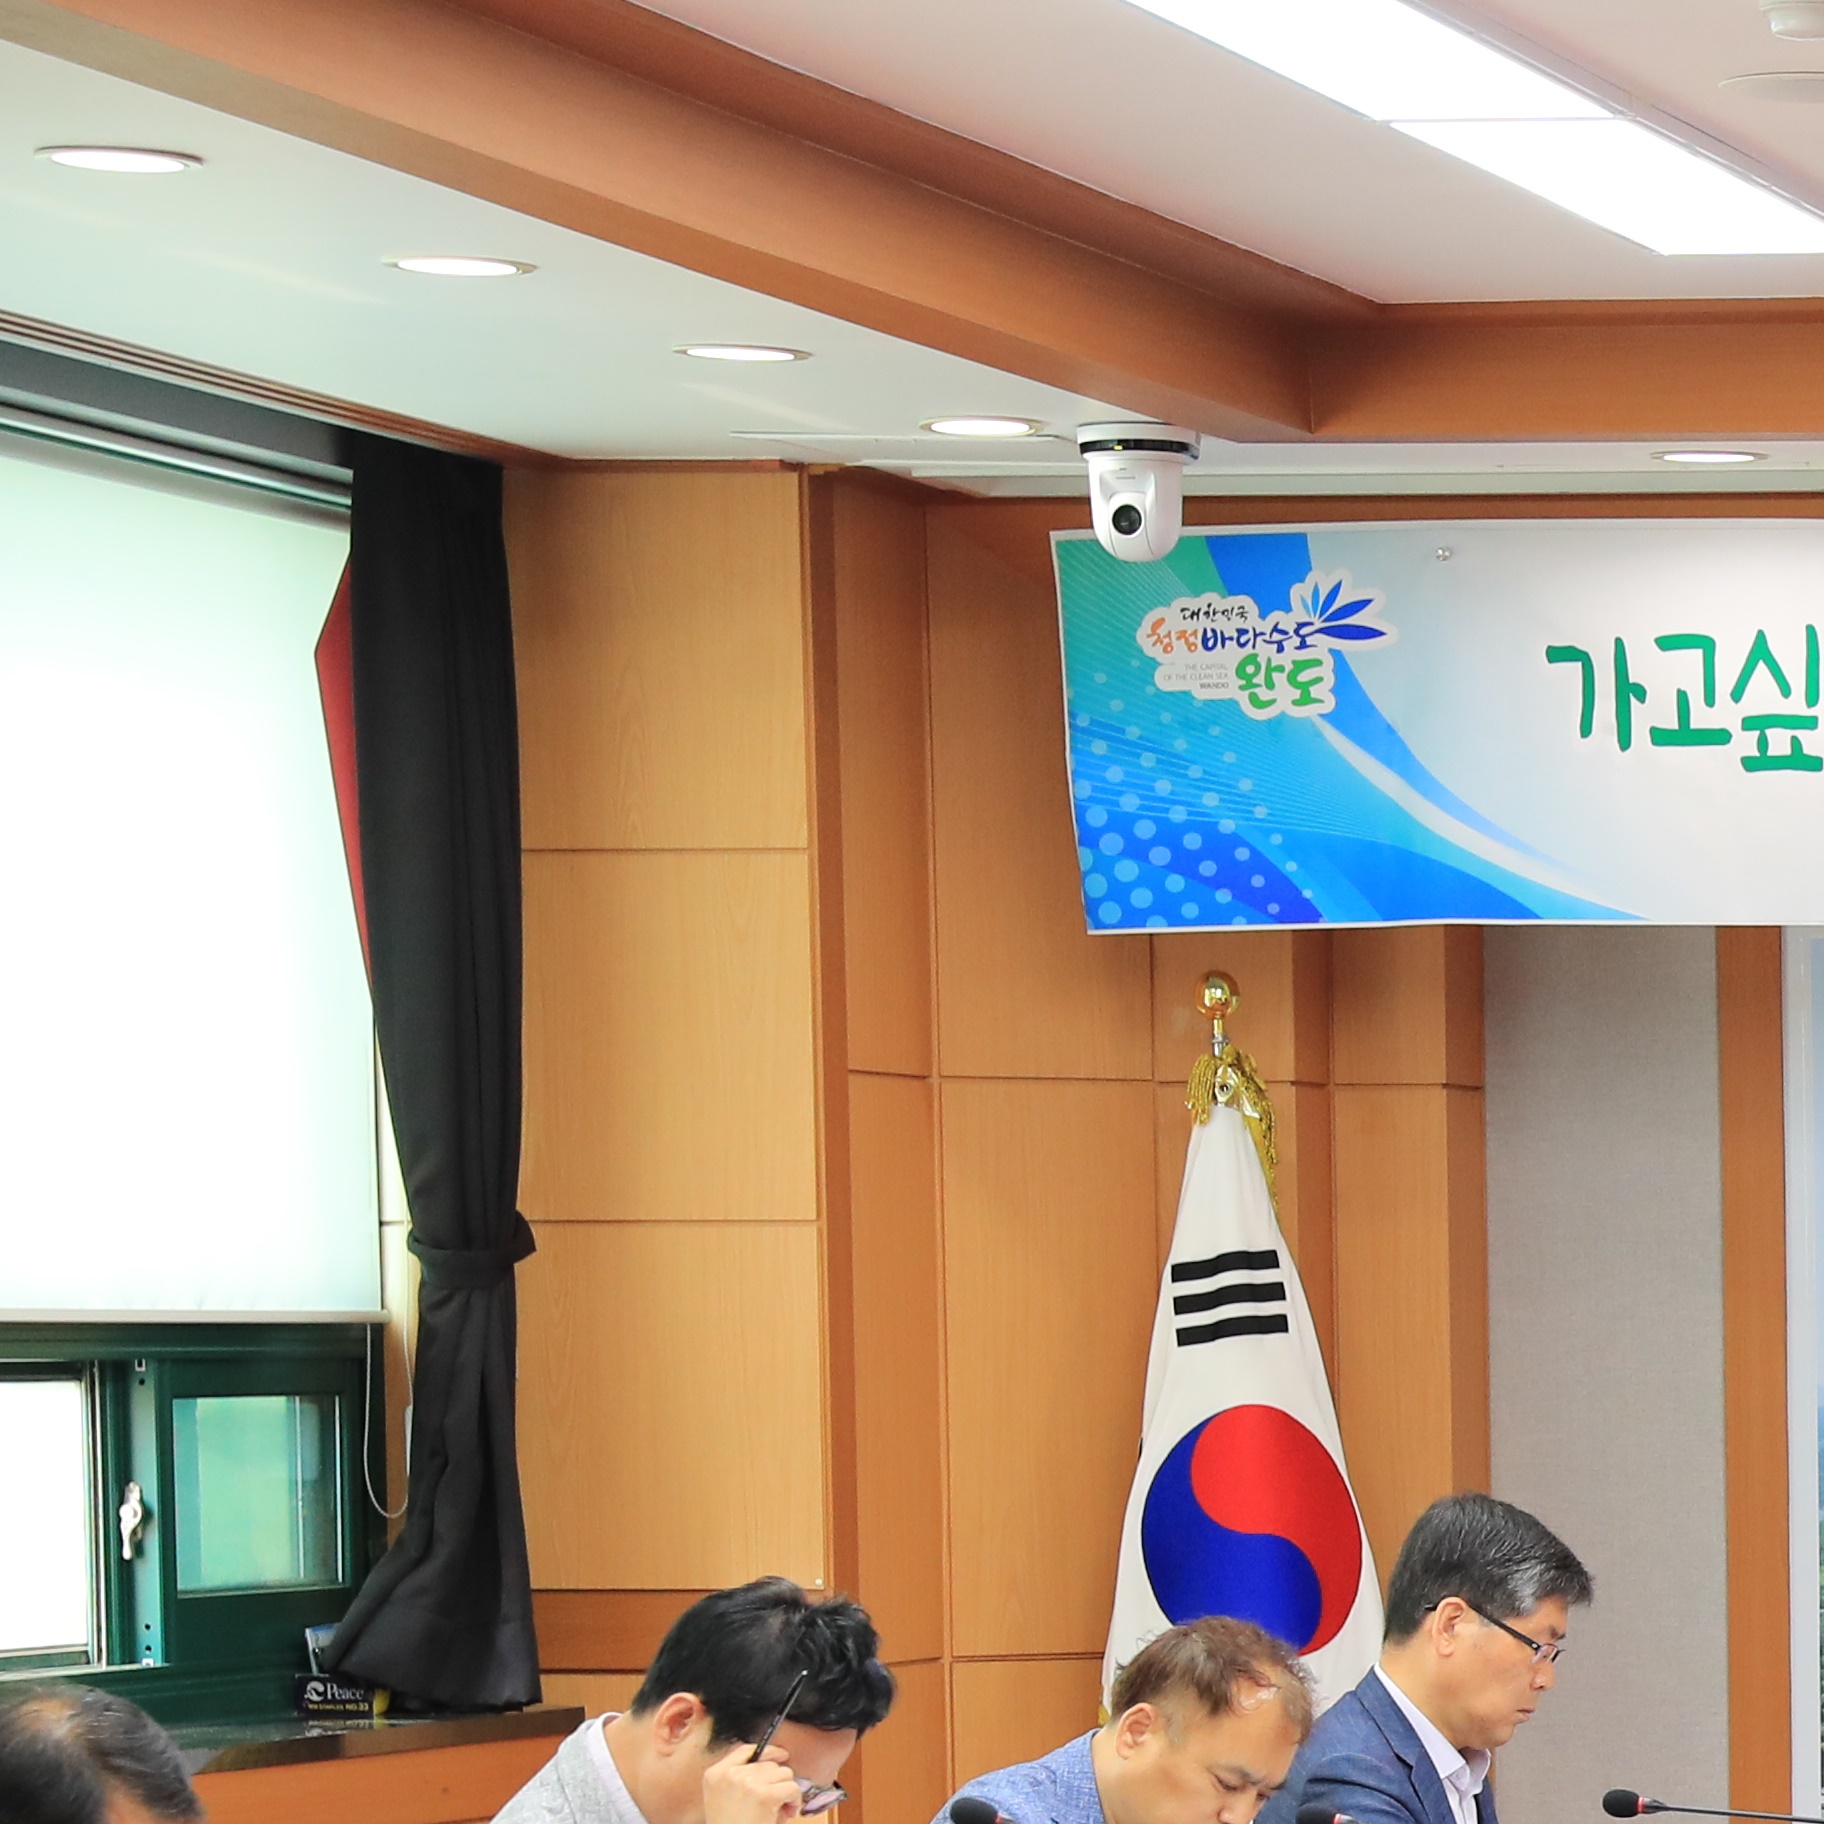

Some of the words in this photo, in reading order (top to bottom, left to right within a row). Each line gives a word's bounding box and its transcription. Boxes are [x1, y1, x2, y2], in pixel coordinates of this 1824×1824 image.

[1180, 603, 1249, 623] 대한민국
[1235, 652, 1325, 710] 완도
[326, 1682, 364, 1700] Peace
